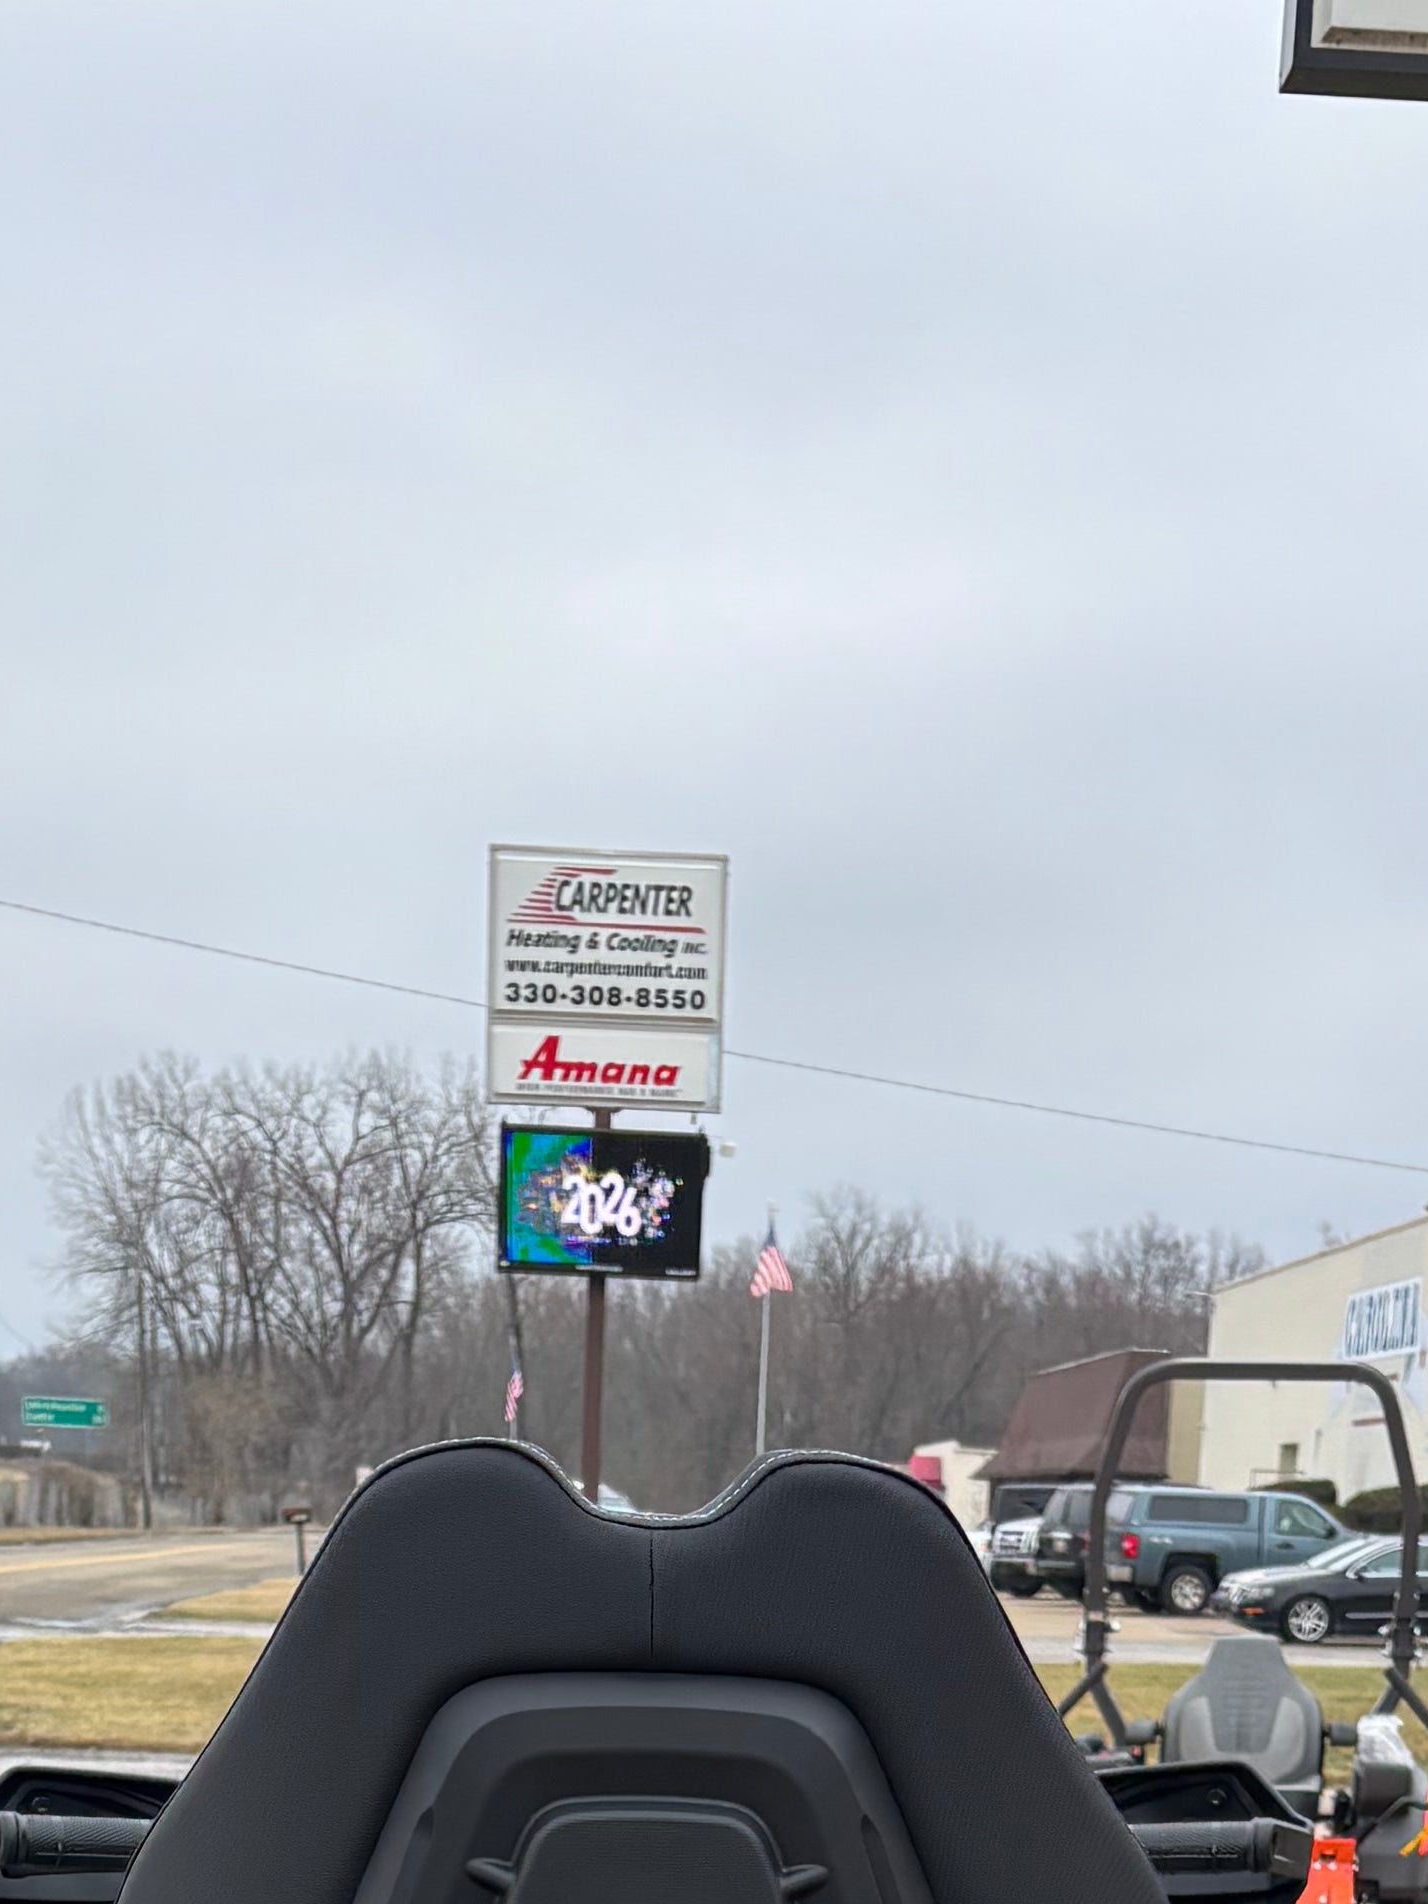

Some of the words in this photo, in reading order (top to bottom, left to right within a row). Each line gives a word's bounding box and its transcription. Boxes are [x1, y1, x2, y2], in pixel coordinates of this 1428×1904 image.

[555, 879, 693, 917] CARPENTER
[506, 928, 582, 954] Heating
[585, 931, 601, 951] &
[606, 932, 678, 958] Cooling
[517, 1035, 681, 1086] Amana
[560, 1172, 642, 1237] 2026
